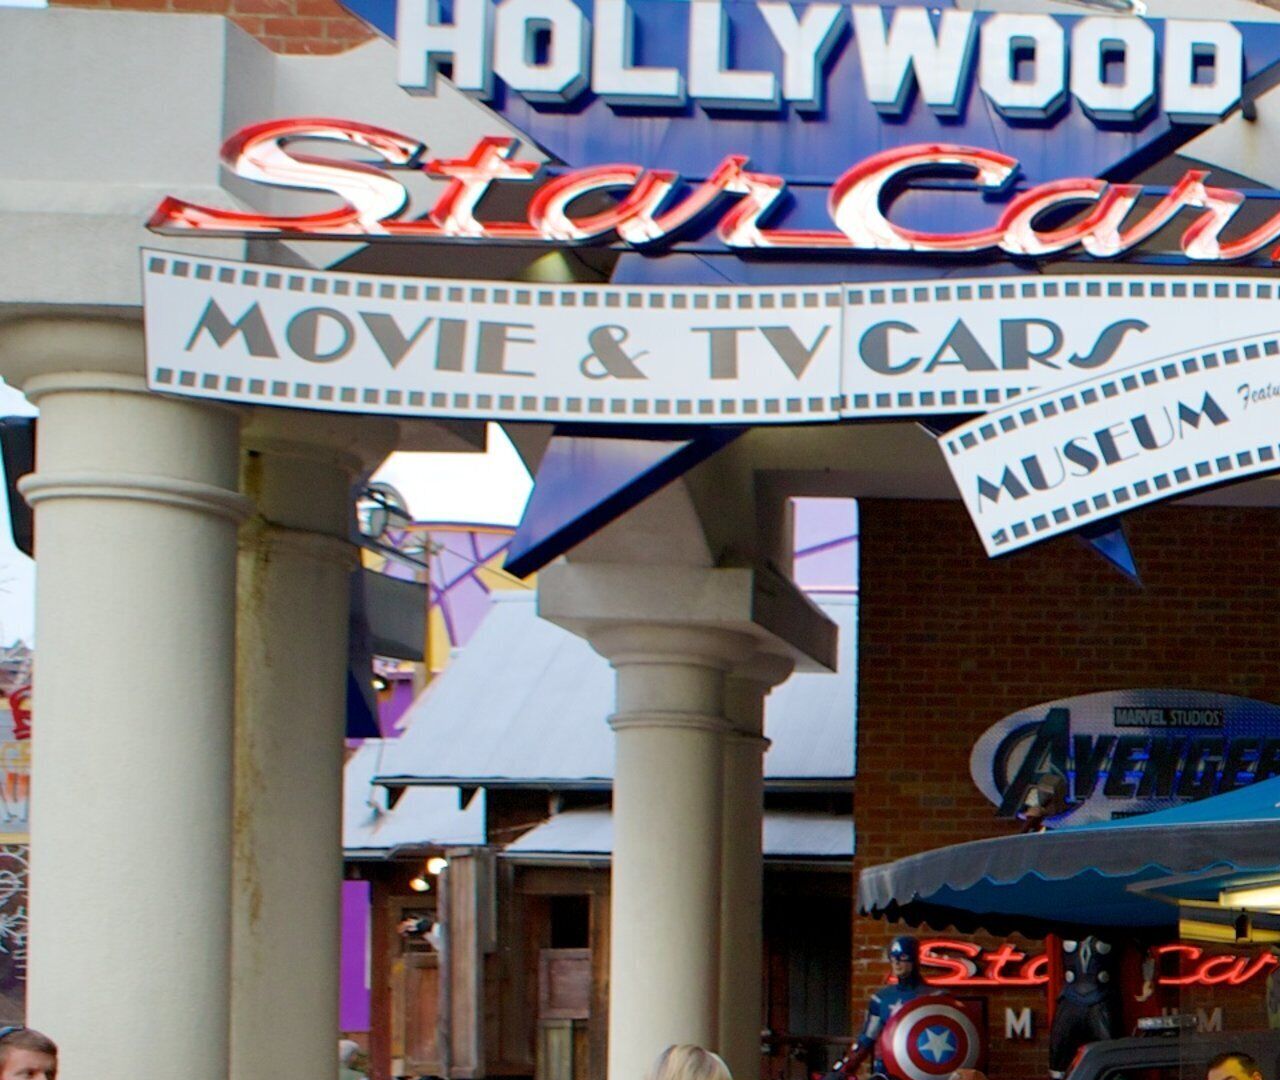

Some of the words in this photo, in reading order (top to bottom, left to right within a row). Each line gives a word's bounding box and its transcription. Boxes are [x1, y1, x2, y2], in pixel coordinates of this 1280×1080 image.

[397, 0, 1245, 122] HOLLYWOOD
[145, 117, 790, 250] Star
[185, 297, 536, 379] MOVIE
[579, 325, 650, 380] &
[690, 326, 830, 381] TV
[858, 318, 1150, 375] CARS
[976, 390, 1230, 514] MUSEUM
[1115, 708, 1167, 727] MARVEL
[1168, 707, 1222, 727] STUDIOS
[1157, 944, 1280, 986] Car
